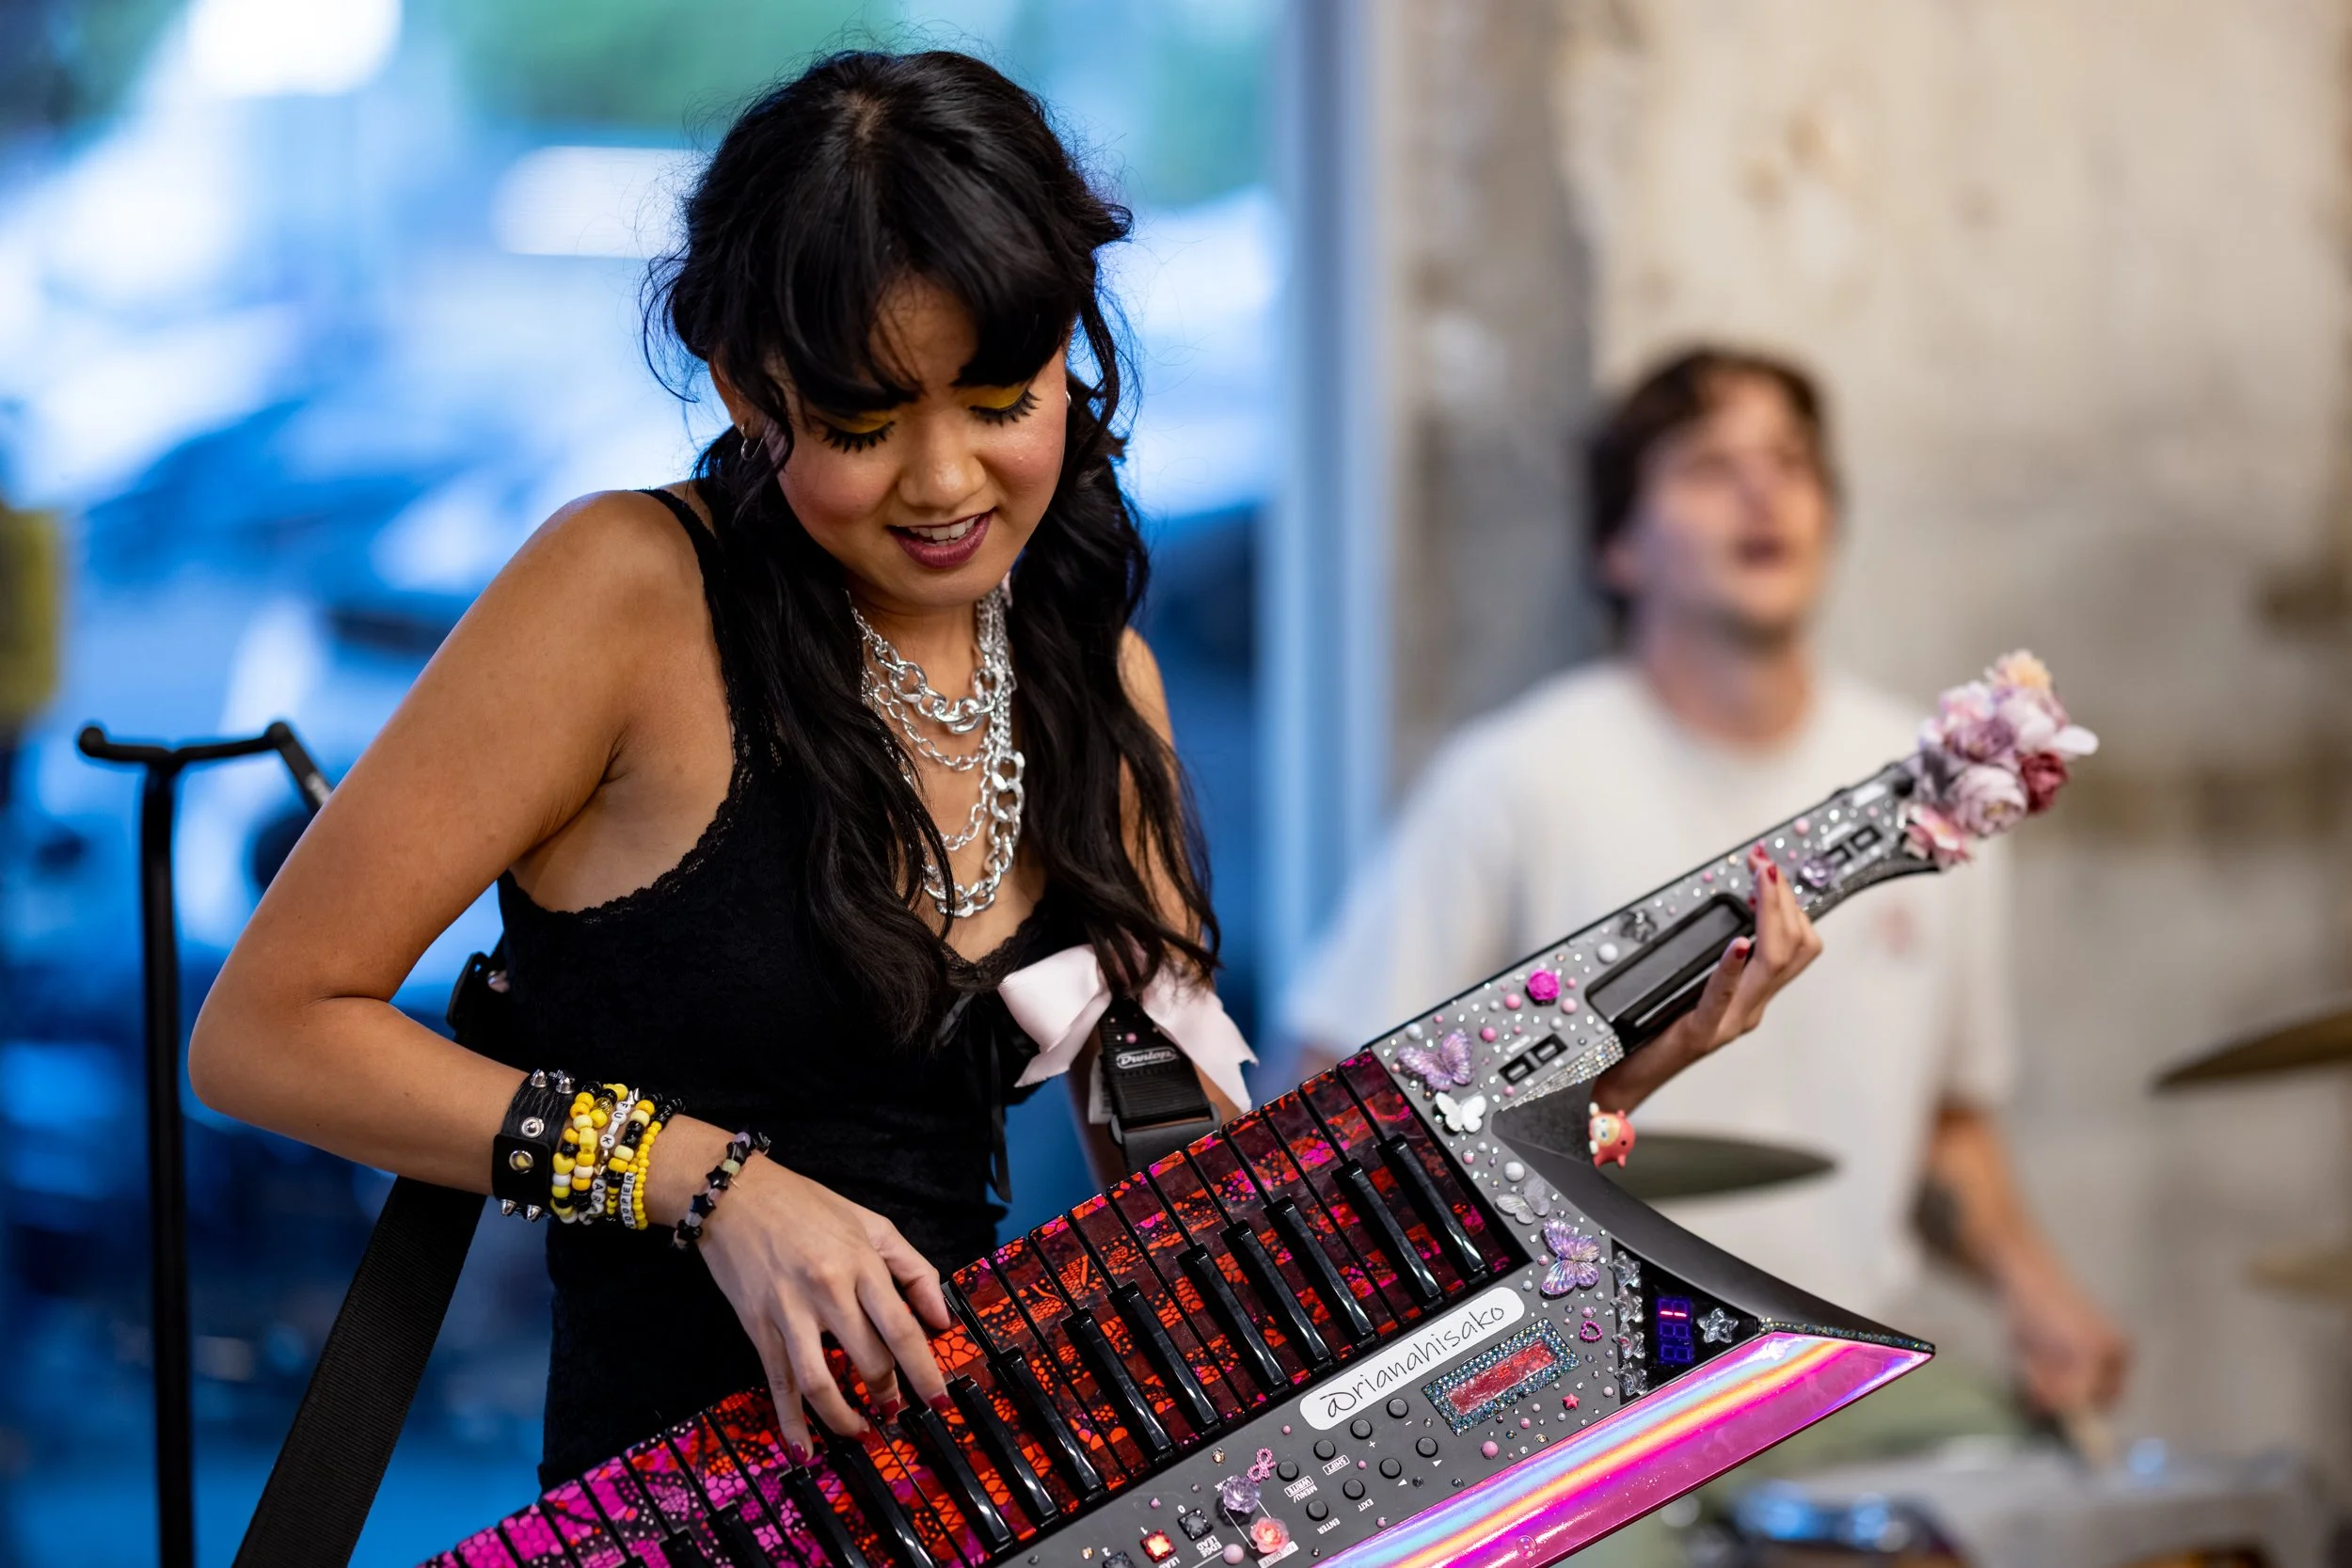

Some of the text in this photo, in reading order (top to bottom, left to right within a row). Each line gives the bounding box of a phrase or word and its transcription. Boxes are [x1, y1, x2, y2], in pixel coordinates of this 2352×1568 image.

[1120, 1050, 1173, 1067] Dunlop
[1327, 1457, 1347, 1473] SHIFT
[1287, 1477, 1311, 1495] WRITE
[1358, 1497, 1374, 1513] EXIT
[1317, 1517, 1341, 1534] ENTER
[1196, 1534, 1217, 1552] LEAD
[1200, 1541, 1222, 1558] EDGE
